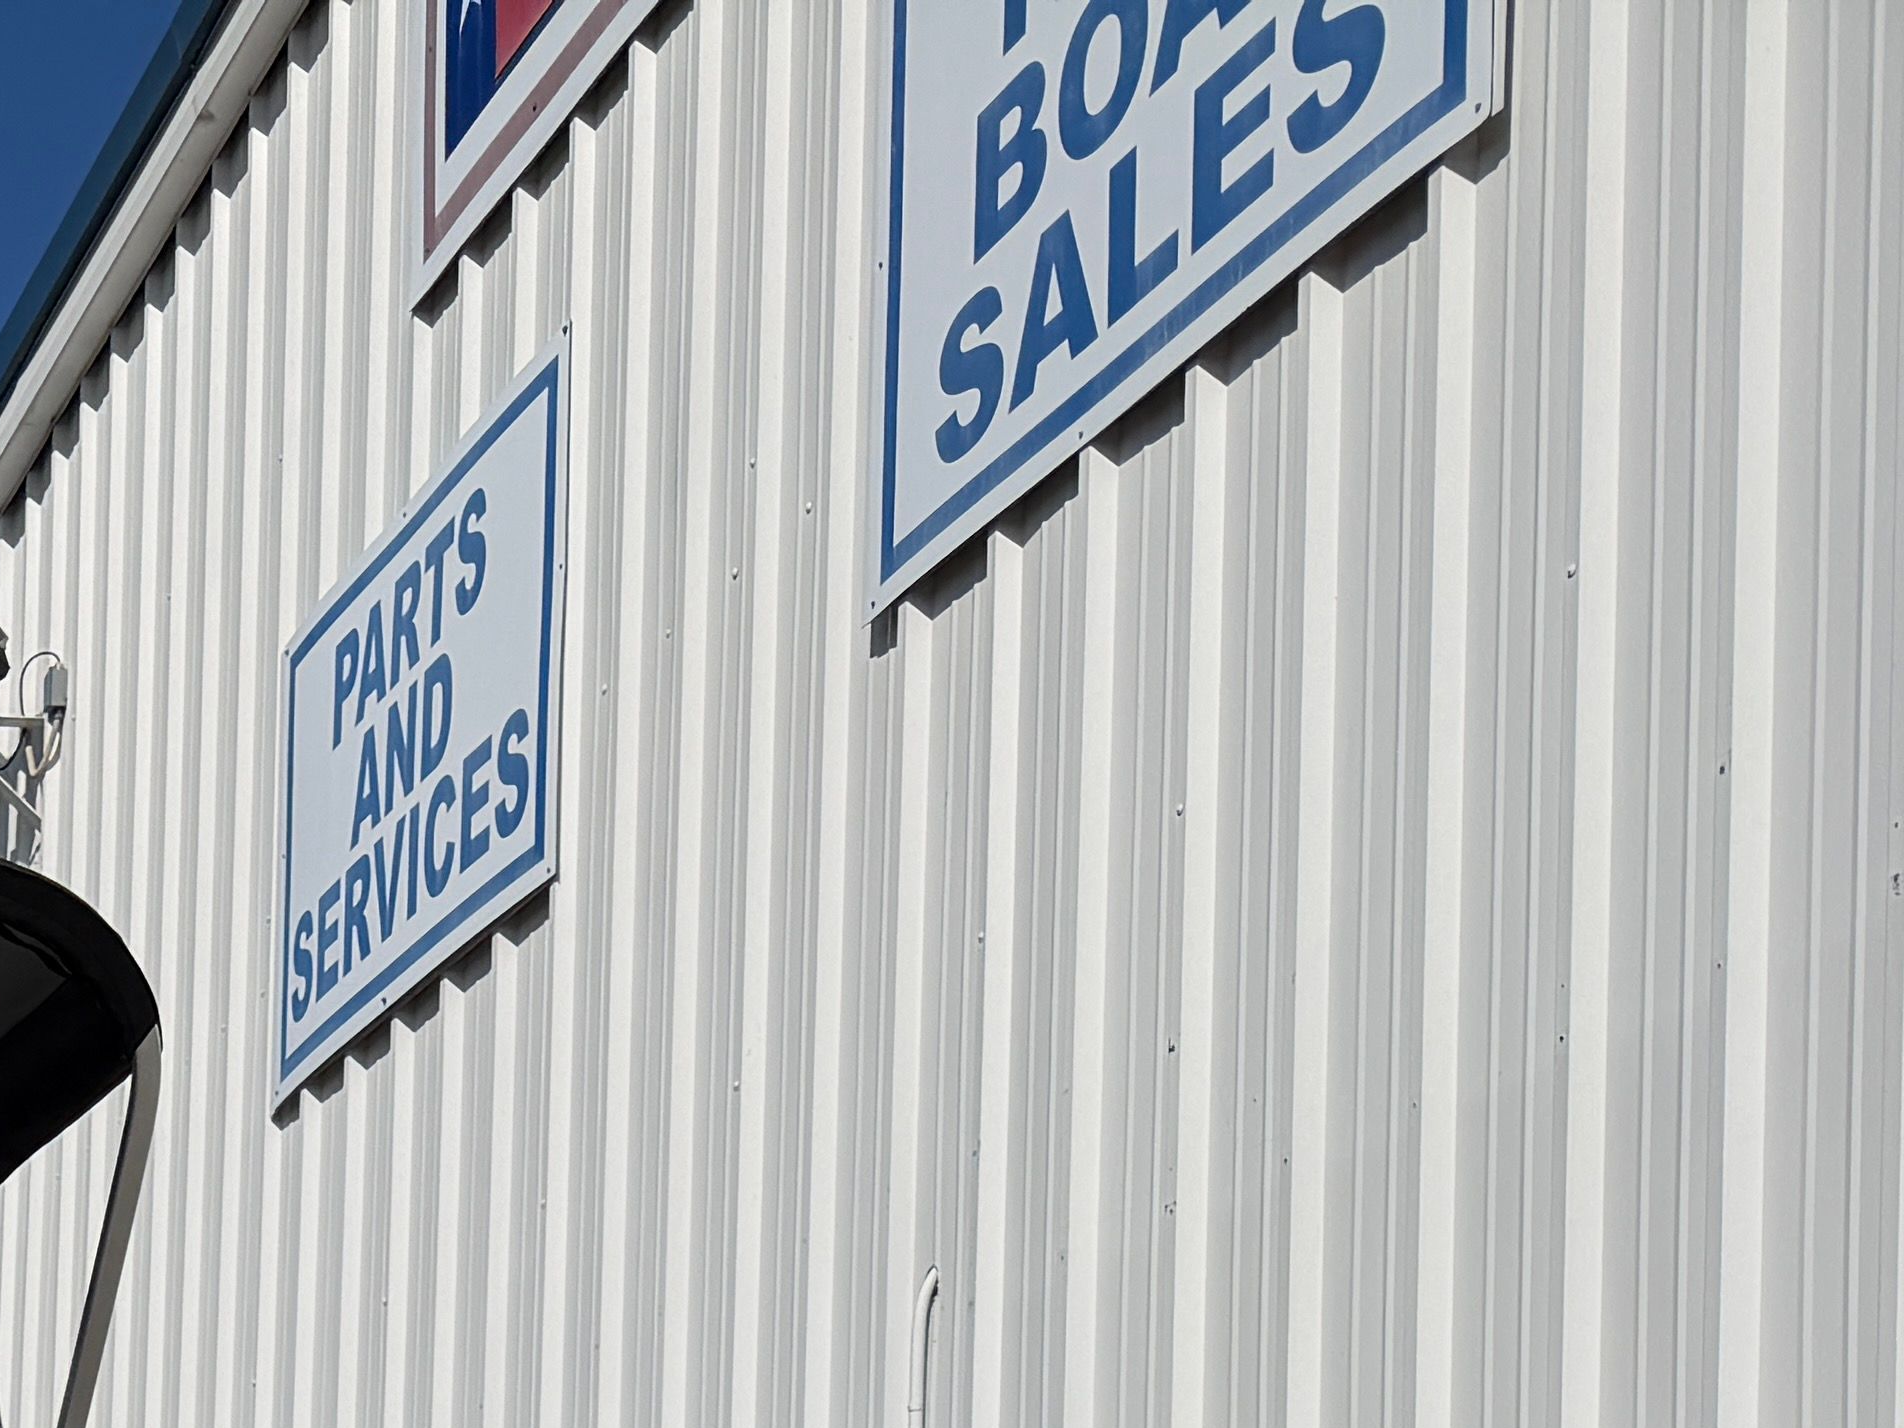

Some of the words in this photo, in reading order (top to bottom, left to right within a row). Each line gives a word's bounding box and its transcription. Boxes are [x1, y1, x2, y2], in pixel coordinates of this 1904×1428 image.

[935, 4, 1386, 464] SALES
[332, 487, 487, 751] PARTS
[349, 652, 453, 852] AND
[292, 708, 530, 1023] SERVICES
